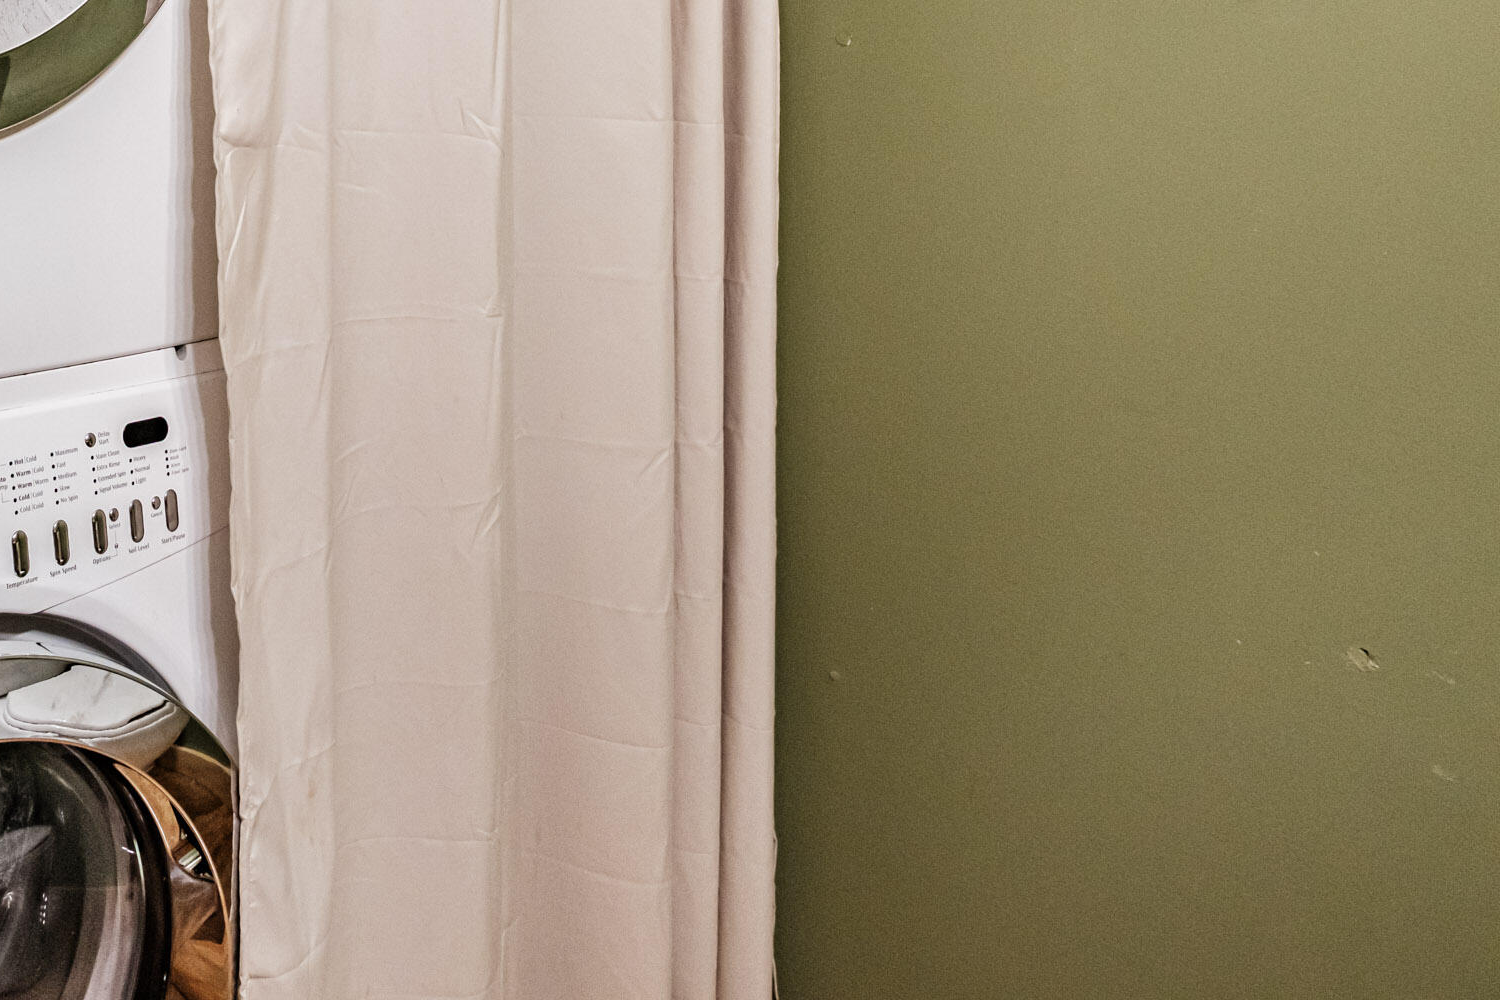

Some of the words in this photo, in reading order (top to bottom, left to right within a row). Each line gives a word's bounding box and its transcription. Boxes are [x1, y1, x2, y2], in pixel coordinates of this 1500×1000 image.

[14, 458, 24, 466] Hot
[26, 455, 37, 463] Cold
[16, 469, 31, 477] Warm
[17, 481, 33, 489] Warm
[18, 493, 30, 502] Cold
[19, 505, 31, 513] Cold
[49, 569, 61, 578] Spin
[62, 564, 77, 574] Speed
[6, 576, 38, 590] Temperature
